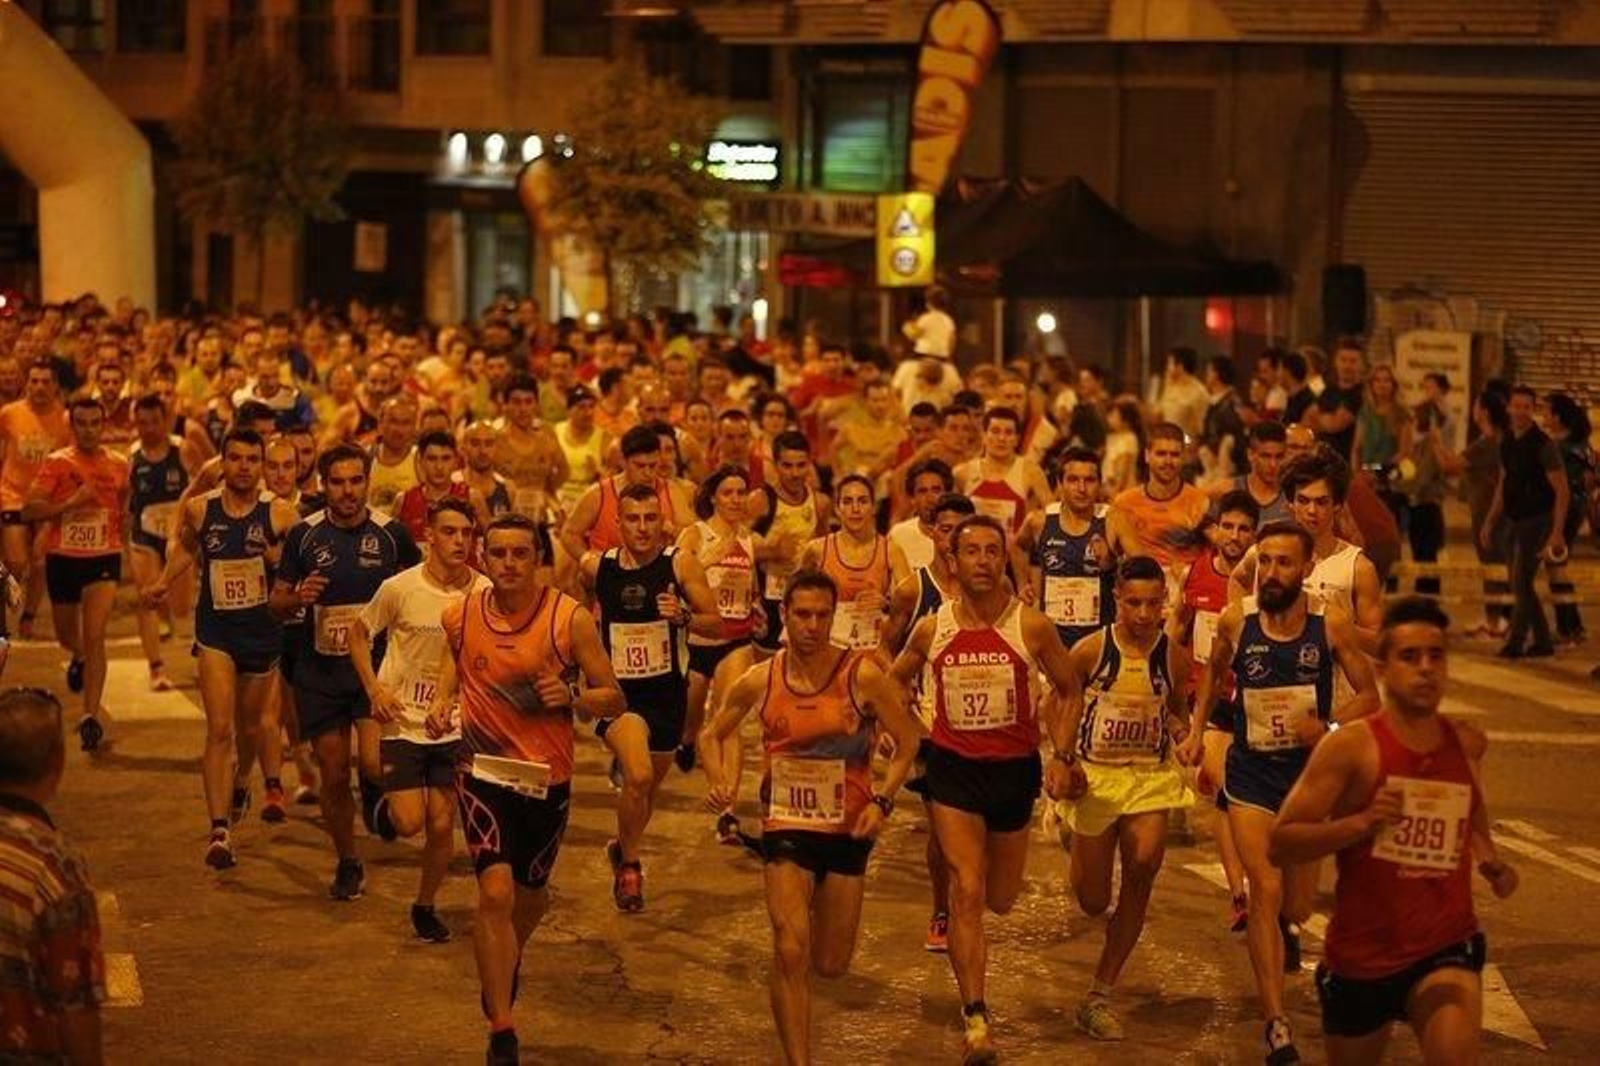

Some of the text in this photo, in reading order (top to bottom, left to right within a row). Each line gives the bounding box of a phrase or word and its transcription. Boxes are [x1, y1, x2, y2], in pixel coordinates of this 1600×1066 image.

[69, 525, 97, 542] 250
[225, 580, 247, 600] 63
[719, 588, 735, 608] 31
[1065, 599, 1075, 617] 3
[626, 646, 649, 668] 131
[945, 652, 1010, 668] O BARCO
[963, 693, 989, 718] 32
[1102, 718, 1148, 742] 3001
[1274, 714, 1287, 739] 5
[790, 785, 818, 810] 110
[1394, 816, 1447, 851] 389
